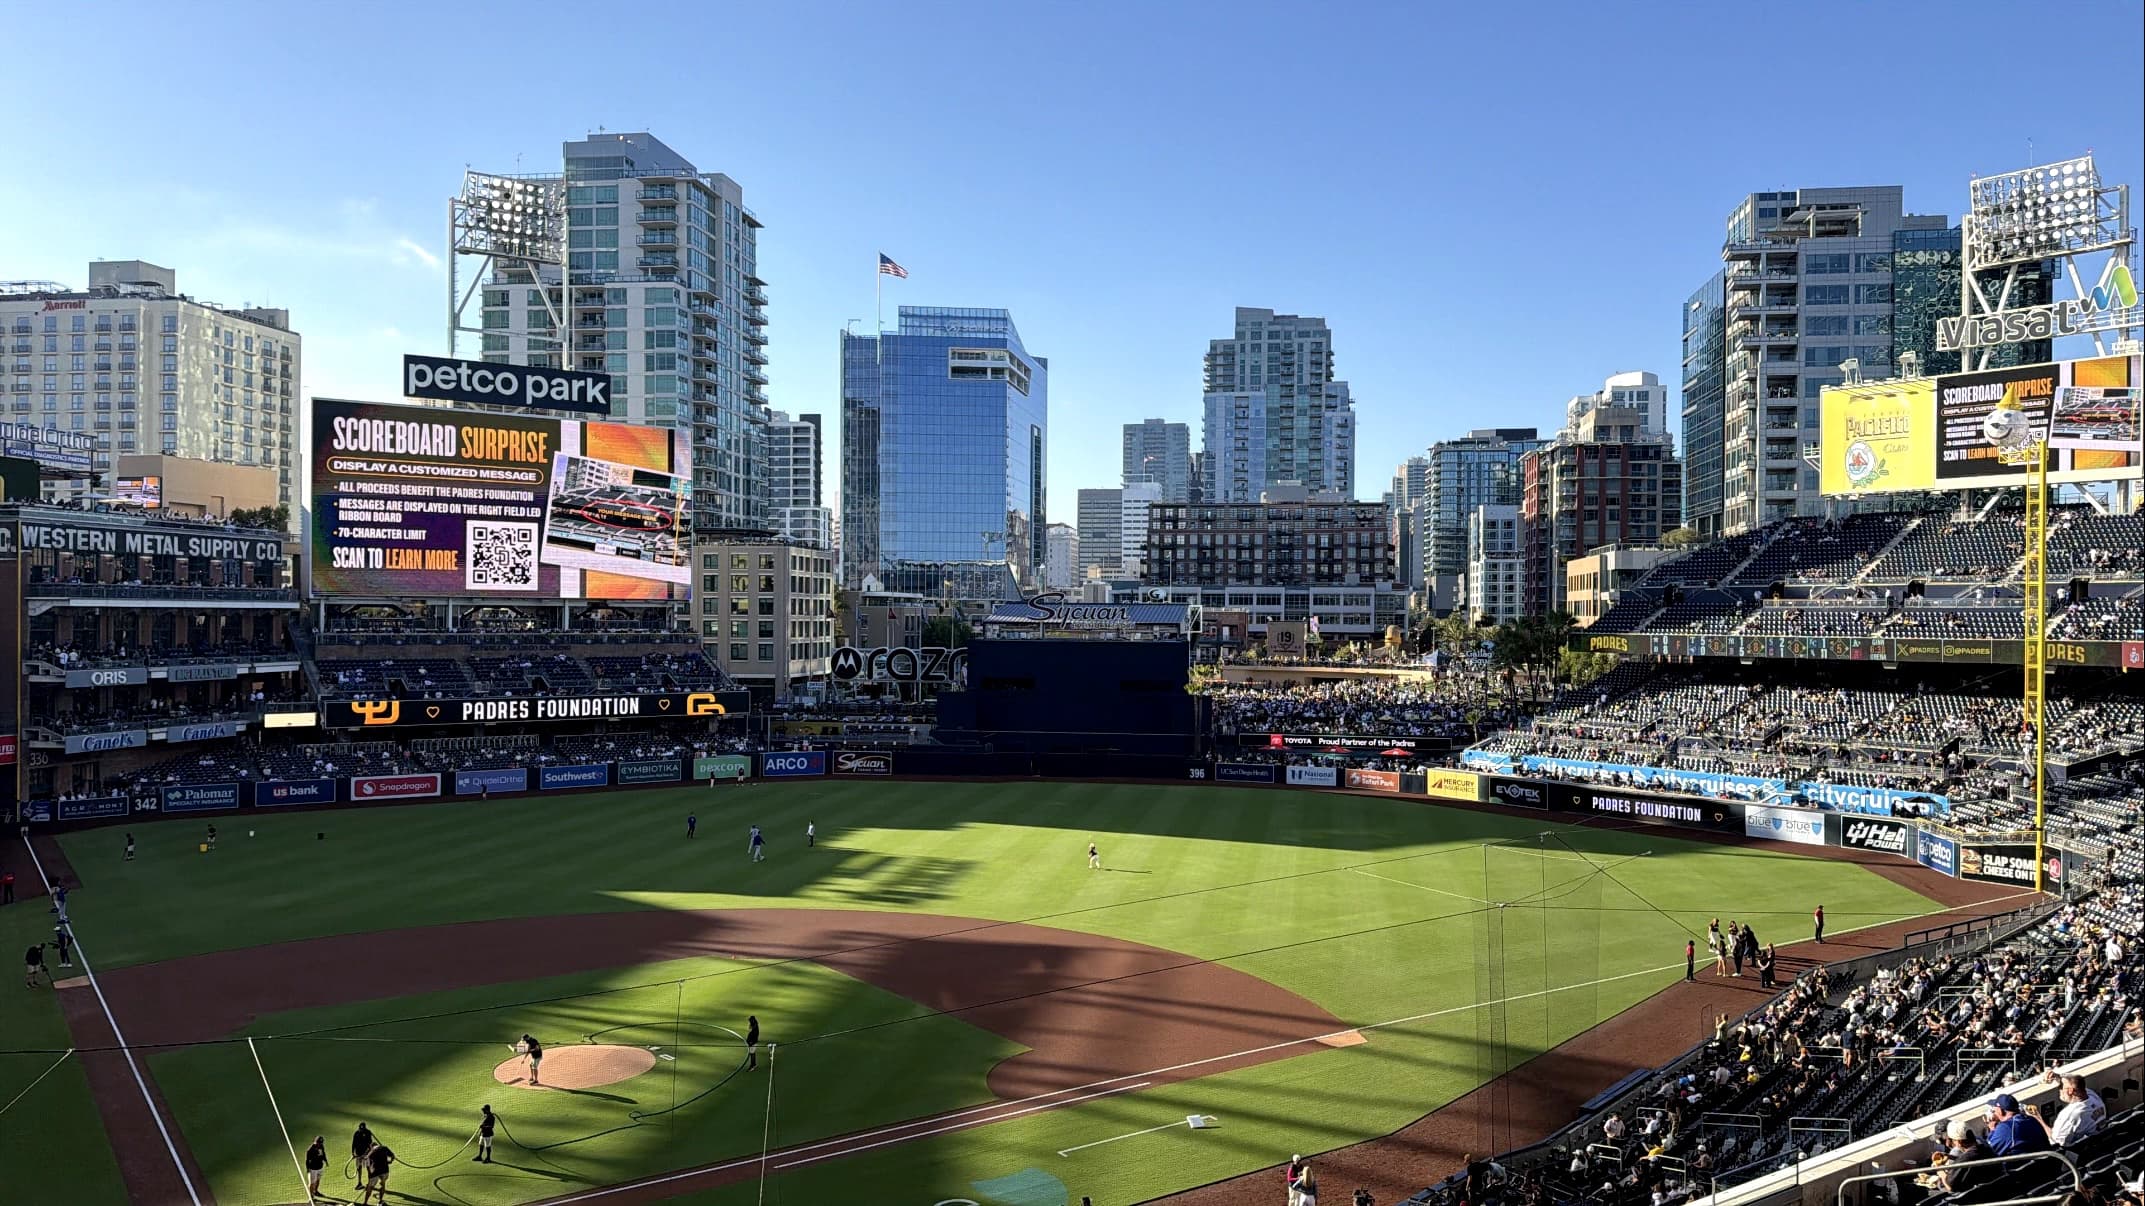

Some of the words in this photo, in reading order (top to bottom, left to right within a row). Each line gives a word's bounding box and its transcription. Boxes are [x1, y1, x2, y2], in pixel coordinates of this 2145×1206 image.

[41, 300, 86, 311] Marriott
[1940, 301, 2076, 349] Viasat
[408, 362, 519, 396] petco
[526, 374, 607, 405] park
[1943, 383, 2004, 405] SCOREBOARD
[333, 416, 456, 457] SCOREBOARD
[461, 426, 548, 464] SURPRISE
[1943, 449, 1959, 461] SCAN
[1960, 449, 1967, 461] TO
[1968, 447, 1986, 460] LEARN
[333, 461, 387, 472] DISPLAY
[388, 464, 398, 473] A
[399, 465, 478, 477] CUSTOMIZED
[479, 469, 537, 481] MESSAGE
[339, 481, 355, 493] ALL
[356, 482, 400, 494] PROCEEDS
[401, 484, 435, 496] BENEFIT
[436, 486, 452, 498] THE
[452, 487, 484, 499] PADRES
[484, 489, 534, 502] FOUNDATION
[338, 498, 385, 510] MESSAGES
[386, 500, 403, 511] ARE
[403, 501, 448, 513] DISPLAYED
[449, 503, 461, 514] ON
[462, 504, 477, 515] THE
[478, 505, 503, 516] RIGHT
[503, 506, 526, 517] FIELD
[526, 507, 541, 518] LED
[338, 510, 372, 522] RIBBON
[372, 512, 402, 523] BOARD
[338, 527, 402, 539] 70-CHARACTER
[403, 529, 427, 540] LIMIT
[22, 525, 117, 552] WESTERN
[126, 532, 185, 556] METAL
[188, 537, 250, 559] SUPPLY
[256, 542, 281, 561] CO.
[332, 546, 365, 569] SCAN
[367, 547, 383, 569] TO
[385, 548, 422, 570] LEARN
[425, 549, 459, 571] MORE
[1027, 592, 1130, 629] Sycuan
[1280, 631, 1292, 642] 19
[1590, 636, 1628, 652] PADRES
[1954, 647, 1991, 655] @PADRES
[2029, 644, 2085, 664] PDRES
[867, 647, 968, 681] razr
[91, 671, 127, 685] ORIS
[462, 700, 529, 721] PADRES
[537, 697, 640, 718] FOUNDATION
[181, 724, 225, 741] Canel's
[82, 732, 135, 751] Canel's
[1284, 737, 1312, 745] TOYOTA
[1318, 737, 1341, 746] Proud
[1341, 737, 1368, 747] Partner
[1368, 738, 1376, 747] of
[1377, 739, 1390, 747] the
[1391, 739, 1416, 748] Padres
[29, 752, 48, 766] 336
[766, 757, 808, 771] ARCO
[837, 753, 885, 772] Sycuan
[472, 775, 524, 786] QuidelOrtho
[544, 771, 597, 783] Southwest
[1189, 768, 1205, 779] 396
[379, 782, 431, 792] Snapdragon
[1443, 778, 1475, 787] MERCURY
[1443, 785, 1475, 794] INSURANCE
[185, 789, 235, 800] Palomar
[273, 788, 288, 797] us
[289, 785, 319, 796] bank
[1496, 784, 1540, 798] EVOTEK
[134, 798, 157, 811] 342
[1592, 796, 1631, 813] PADRES
[1634, 801, 1701, 822] FOUNDATION
[1747, 815, 1771, 827] blue
[1786, 820, 1811, 831] blue
[1864, 839, 1904, 851] POWER
[1928, 842, 1952, 863] petco
[1983, 854, 2008, 867] SLAP
[1983, 866, 2013, 878] CHEESE
[2014, 868, 2028, 880] ON
